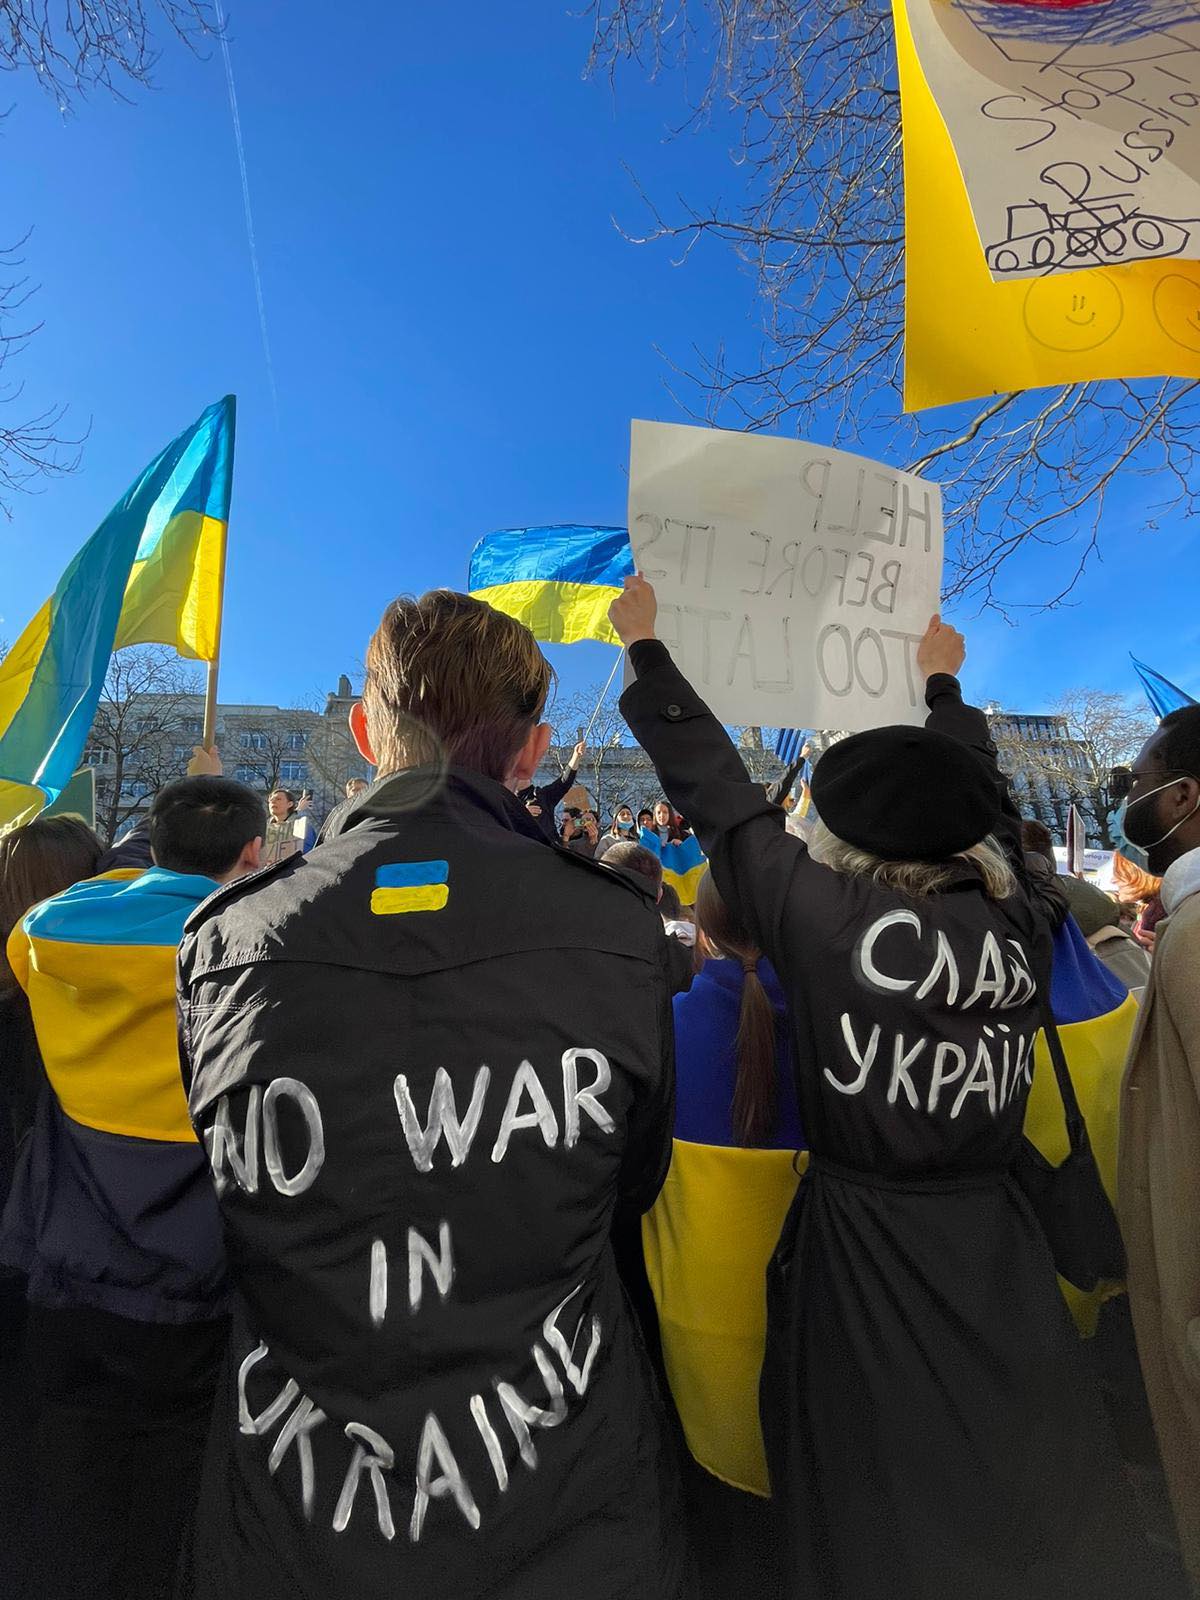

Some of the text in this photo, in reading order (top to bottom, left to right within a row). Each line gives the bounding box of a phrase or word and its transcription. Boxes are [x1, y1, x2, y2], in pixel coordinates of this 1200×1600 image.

[204, 1048, 616, 1200] NO WAR
[369, 1219, 456, 1328] IN
